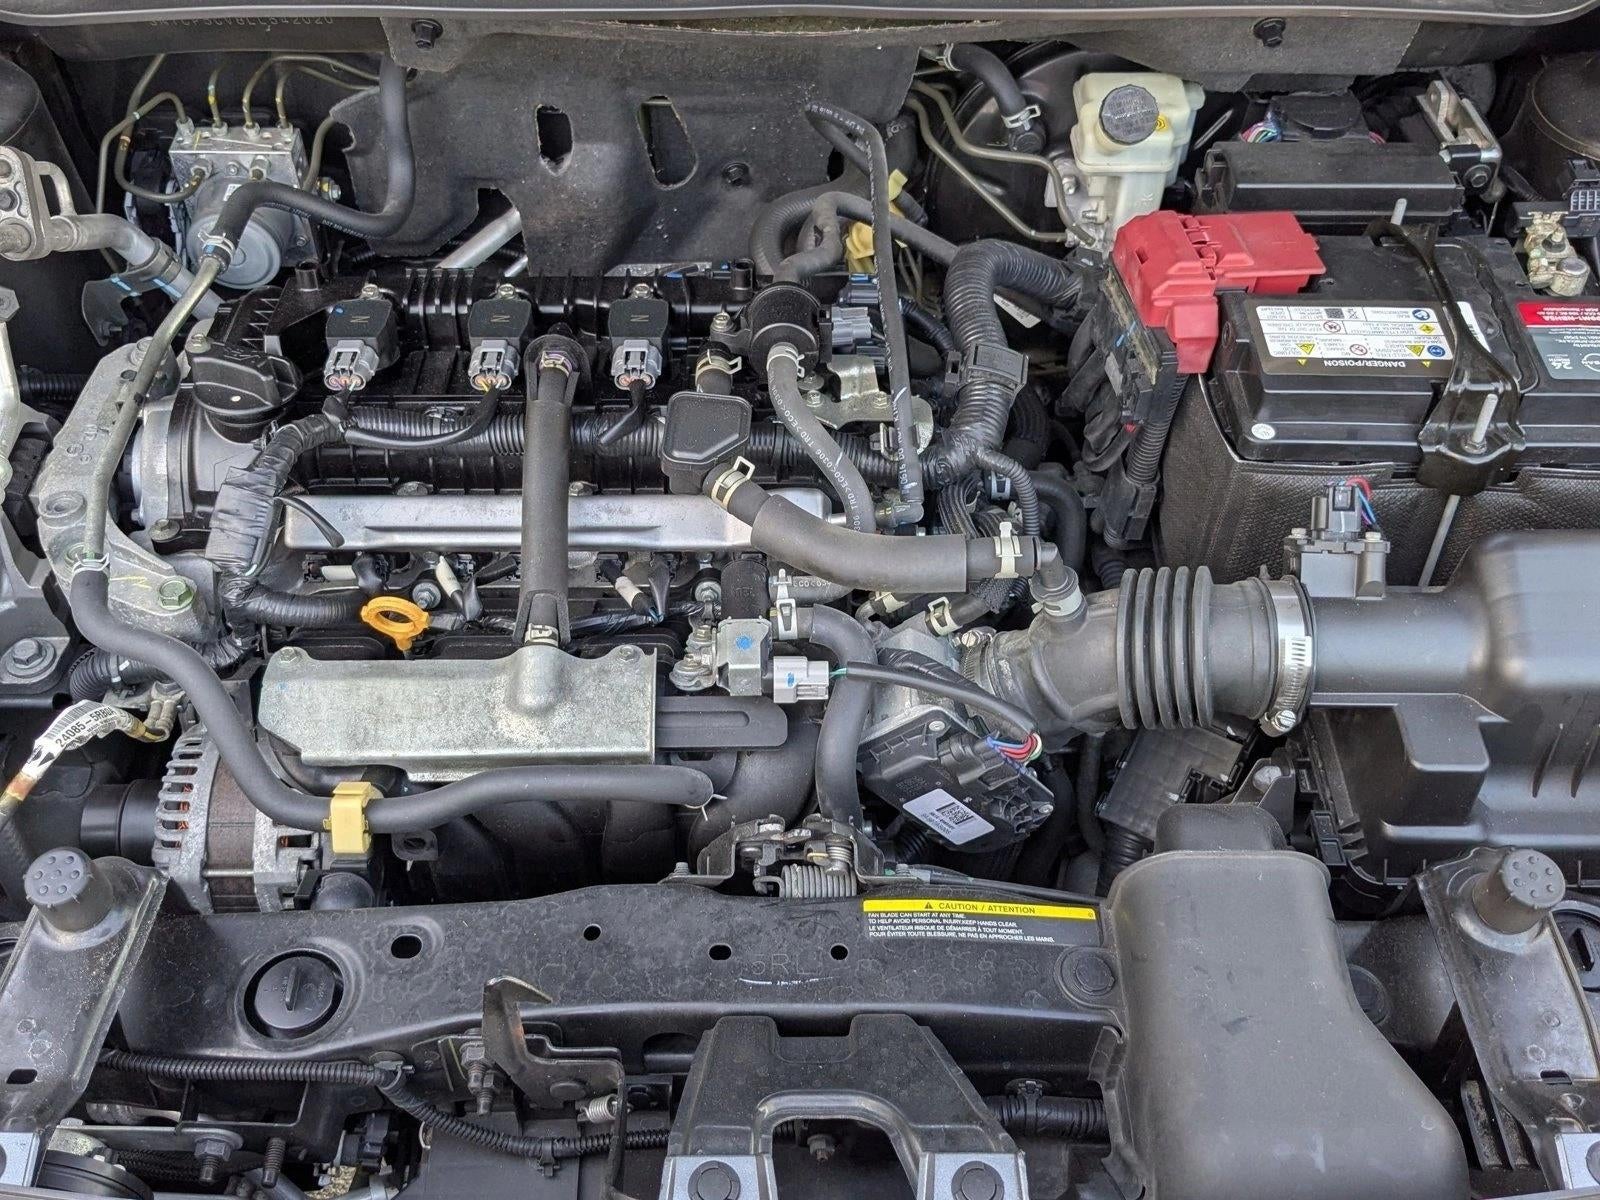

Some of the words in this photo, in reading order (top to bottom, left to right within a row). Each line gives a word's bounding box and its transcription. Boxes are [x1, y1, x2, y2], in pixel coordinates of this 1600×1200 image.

[938, 902, 978, 911] CAUTION
[987, 904, 1036, 914] ATTENTION
[945, 924, 977, 932] DÉMARRER
